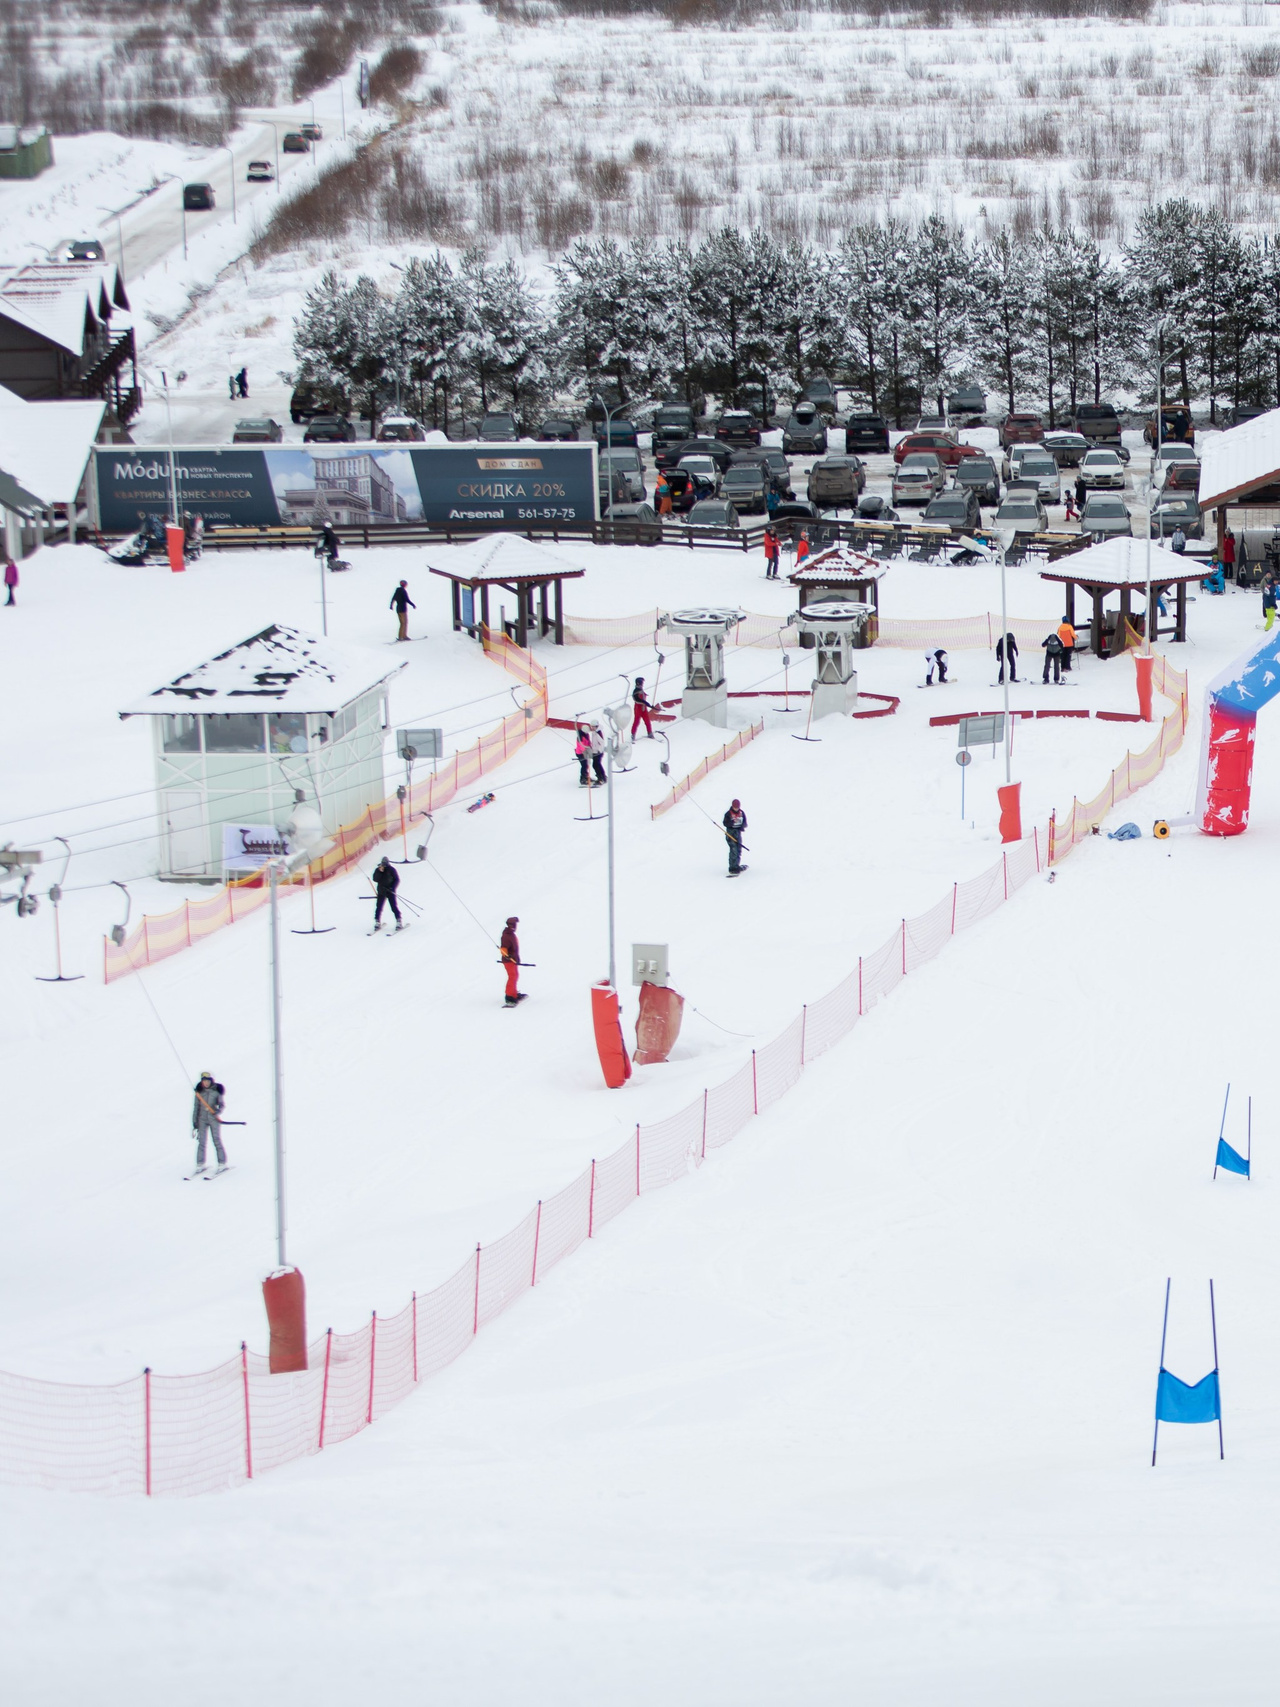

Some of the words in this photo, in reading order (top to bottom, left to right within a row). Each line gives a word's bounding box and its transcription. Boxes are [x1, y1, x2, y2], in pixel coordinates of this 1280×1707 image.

[114, 489, 166, 499] КВАРТИРЫ
[168, 489, 253, 499] БИЗНЕС-КЛАССА
[458, 483, 527, 499] СКИДКА
[533, 483, 566, 497] 20%
[205, 511, 232, 519] РАЙОН
[449, 509, 505, 519] Arsenal
[518, 508, 576, 519] 561-57-75
